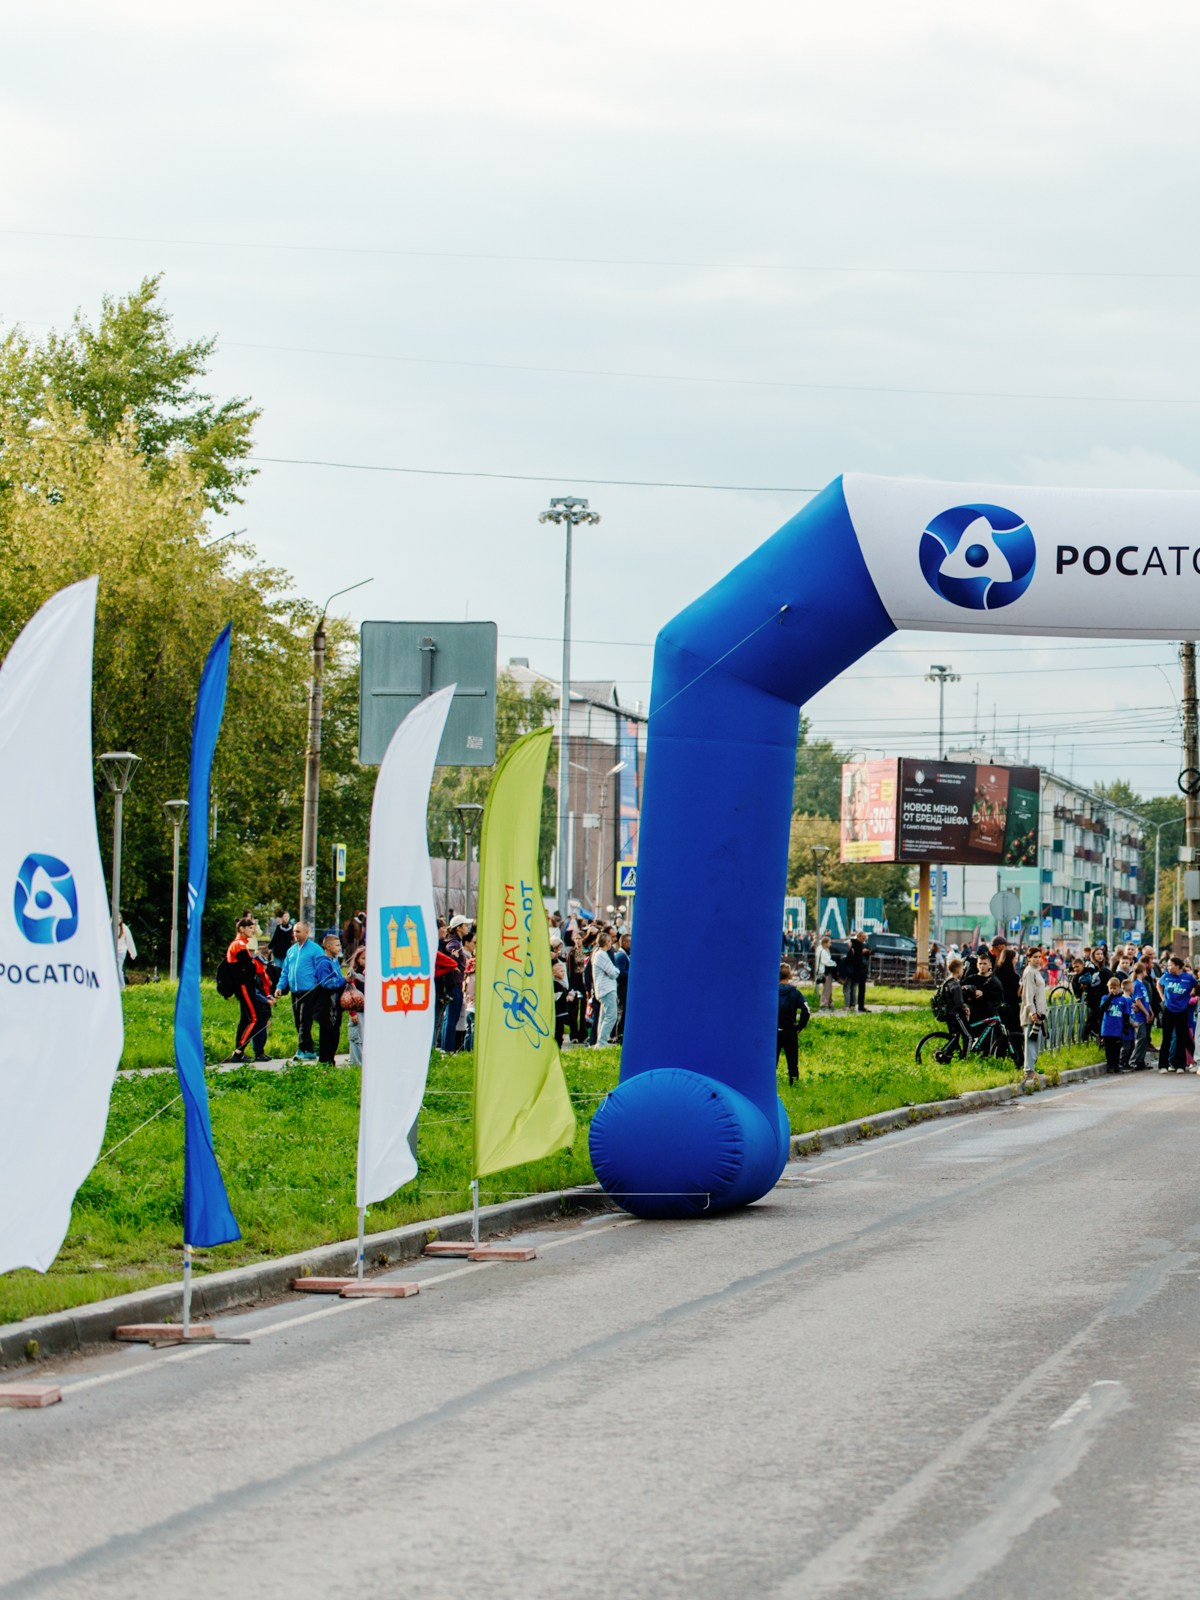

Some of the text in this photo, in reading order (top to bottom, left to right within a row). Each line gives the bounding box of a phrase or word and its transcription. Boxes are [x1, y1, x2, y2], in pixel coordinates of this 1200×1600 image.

[903, 802, 958, 815] НОВОЕ МЕНЮ
[903, 813, 969, 826] ОТ БРЕНД-ШЕФА
[502, 884, 522, 963] АТОМ
